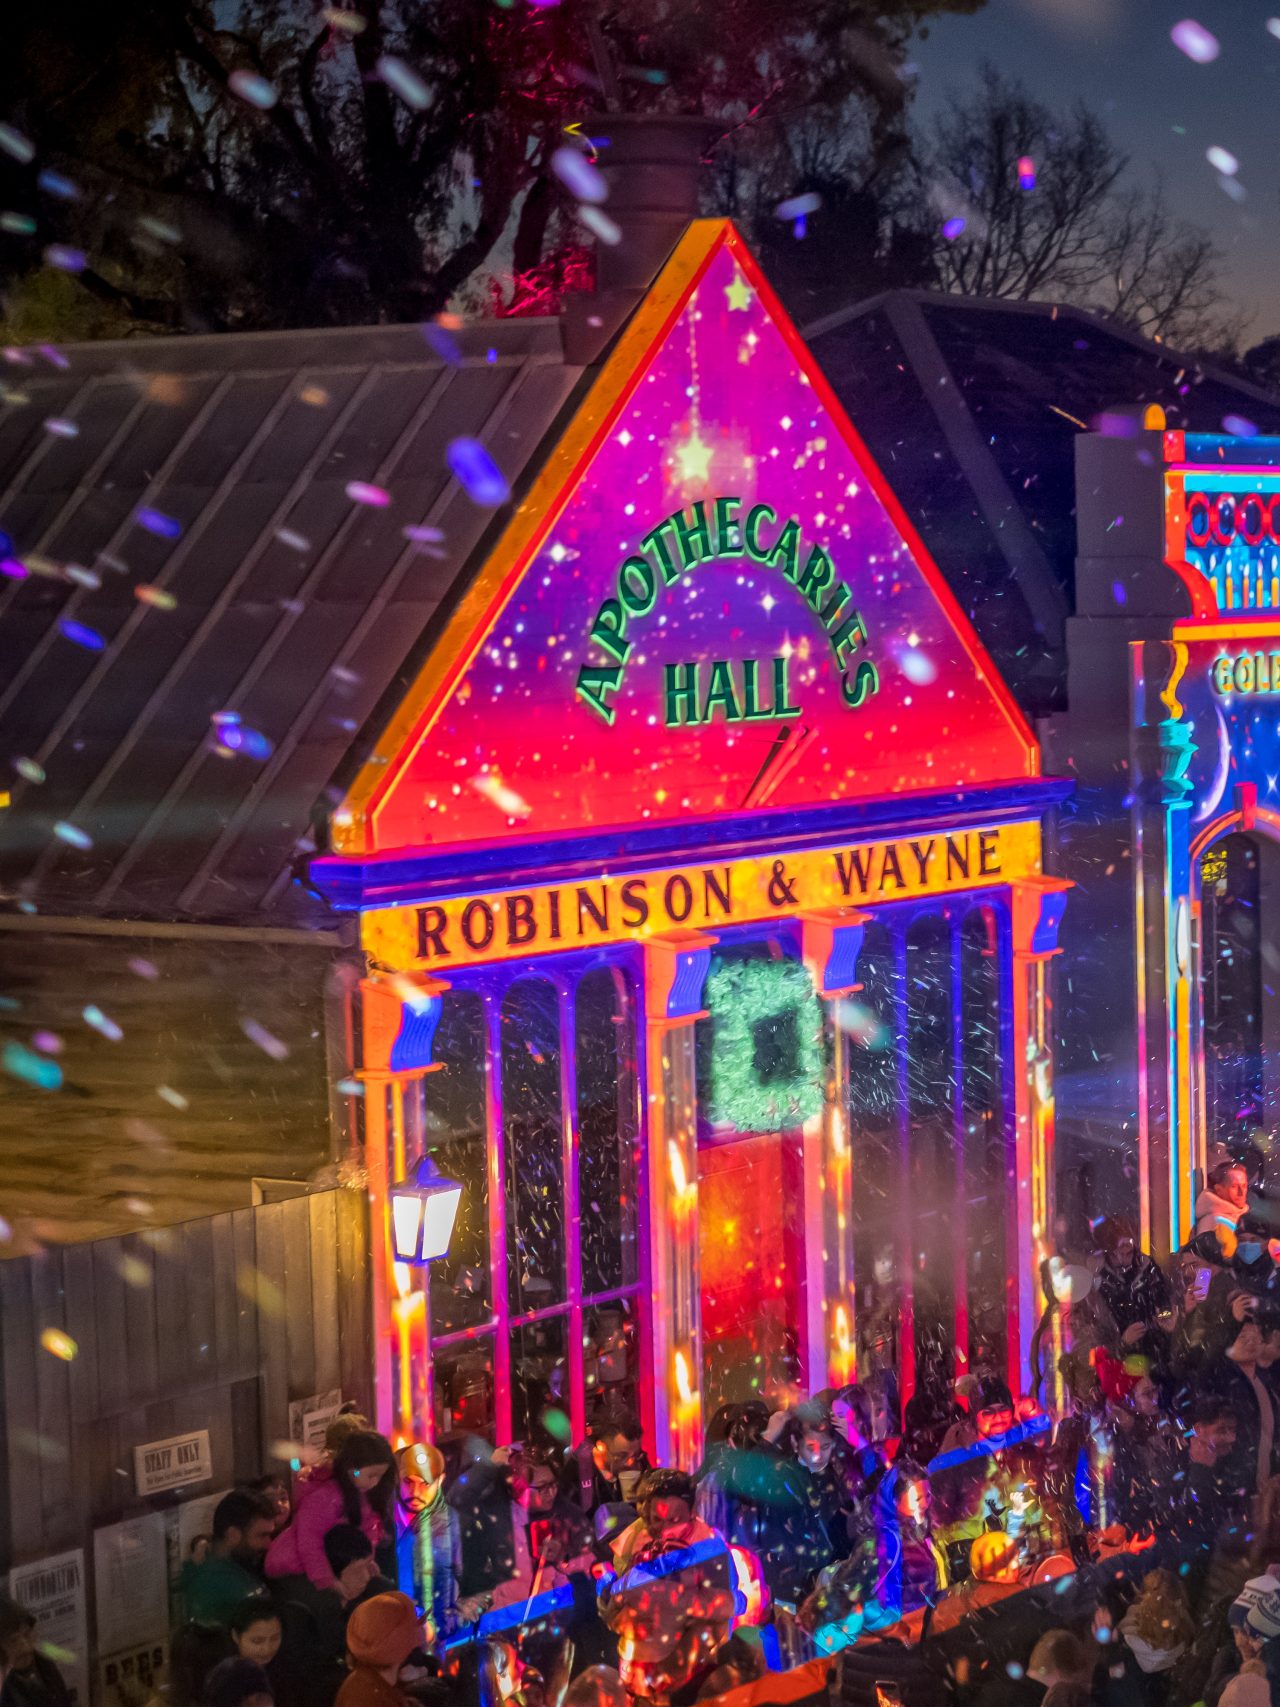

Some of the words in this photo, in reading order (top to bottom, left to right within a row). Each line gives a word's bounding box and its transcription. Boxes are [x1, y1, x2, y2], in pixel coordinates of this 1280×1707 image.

[576, 497, 879, 726] APOTHECARIES
[664, 657, 802, 727] HALL
[415, 867, 733, 958] ROBINSON
[768, 859, 799, 906] &
[833, 829, 1001, 895] WAYNE
[144, 1449, 172, 1474] STAFF
[177, 1442, 200, 1465] ONLY
